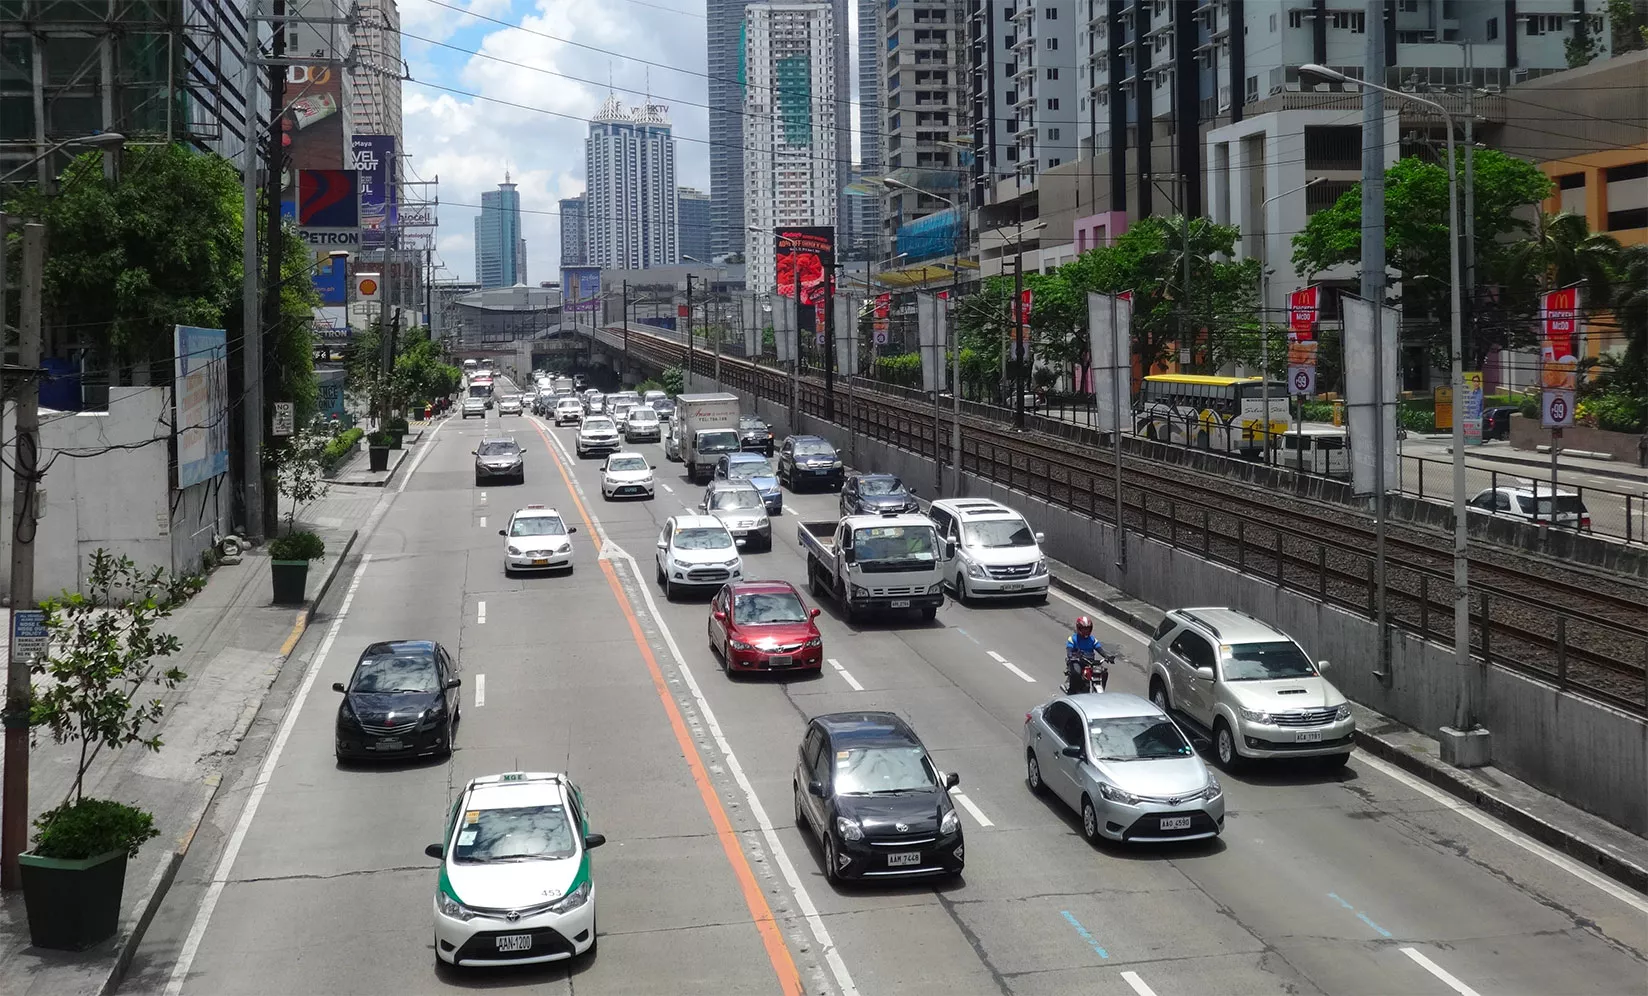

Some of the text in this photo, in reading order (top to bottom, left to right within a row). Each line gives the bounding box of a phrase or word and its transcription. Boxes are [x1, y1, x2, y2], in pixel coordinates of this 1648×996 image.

[352, 151, 379, 162] VEL
[299, 231, 359, 244] PETRON
[541, 889, 562, 897] 453
[498, 936, 531, 950] AAN-1200
